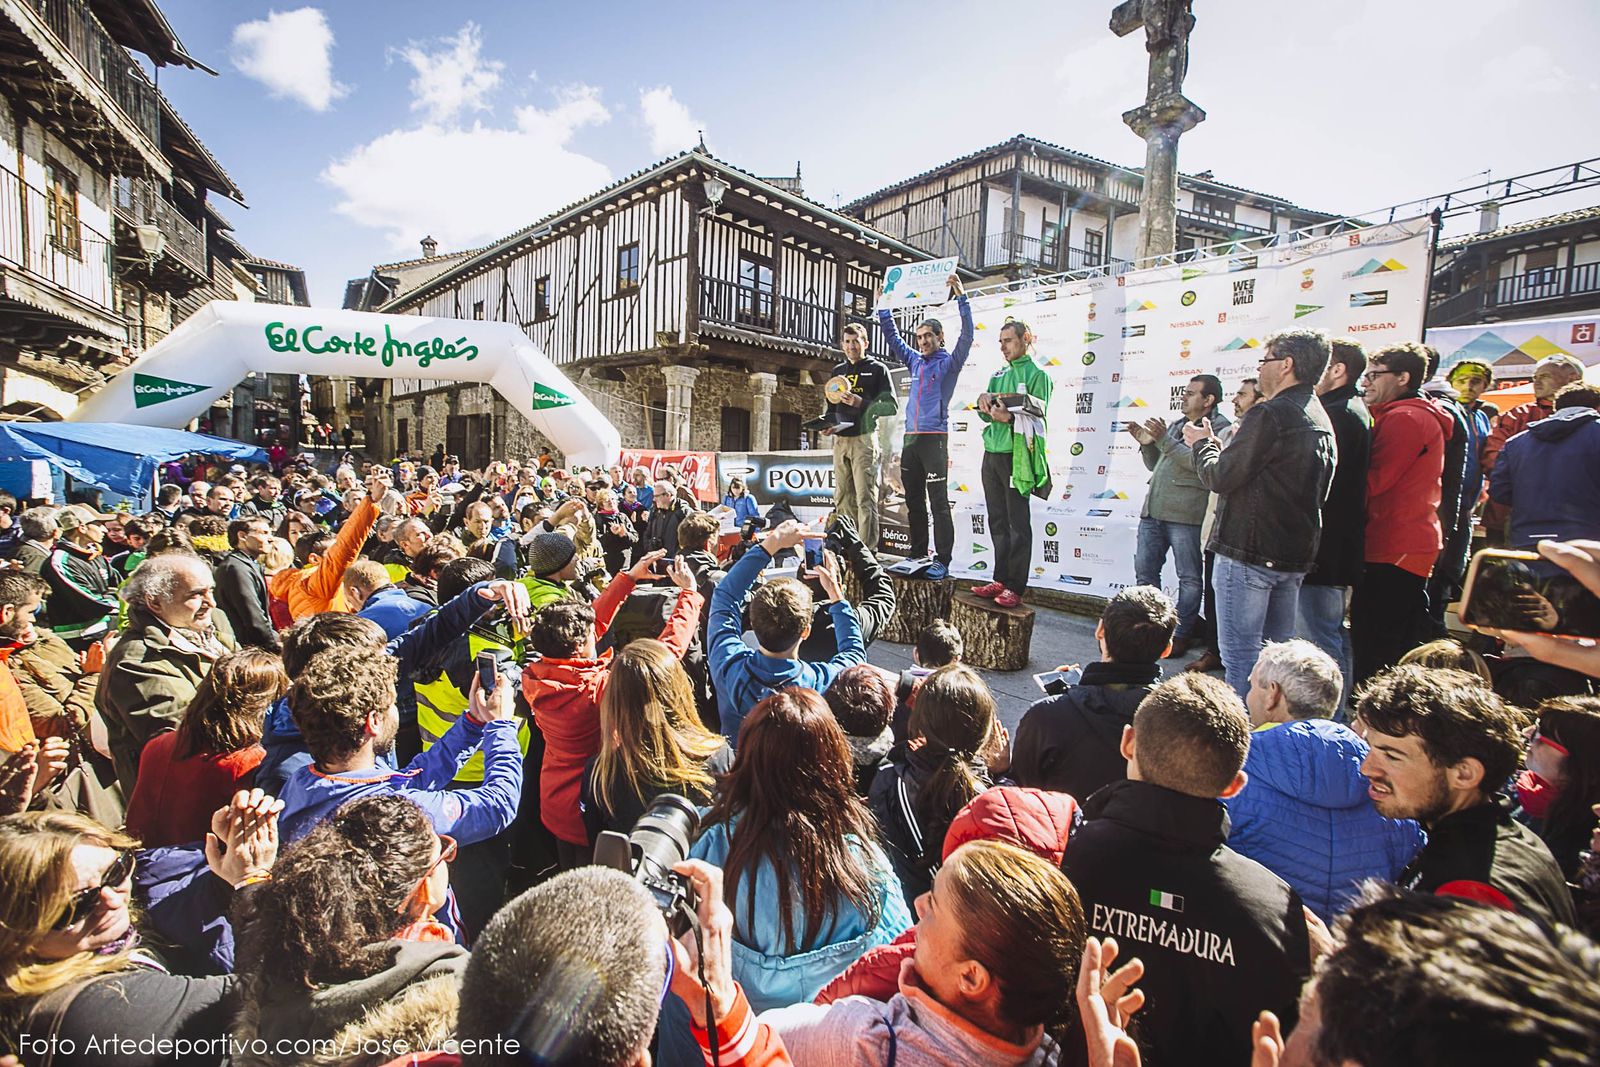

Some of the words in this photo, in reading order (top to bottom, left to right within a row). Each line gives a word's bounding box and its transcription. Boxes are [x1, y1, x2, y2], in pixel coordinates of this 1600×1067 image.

[909, 261, 954, 276] PREMIO
[1233, 295, 1254, 306] WILD
[1170, 320, 1205, 328] NISSAN
[1348, 322, 1396, 332] NISSAN
[265, 322, 300, 352] El
[302, 326, 376, 356] Corte
[381, 324, 479, 368] Inglés
[1169, 368, 1203, 376] NISSAN
[882, 528, 908, 541] ibérico
[1044, 555, 1059, 563] WILD
[1092, 903, 1236, 966] EXTREMADURA
